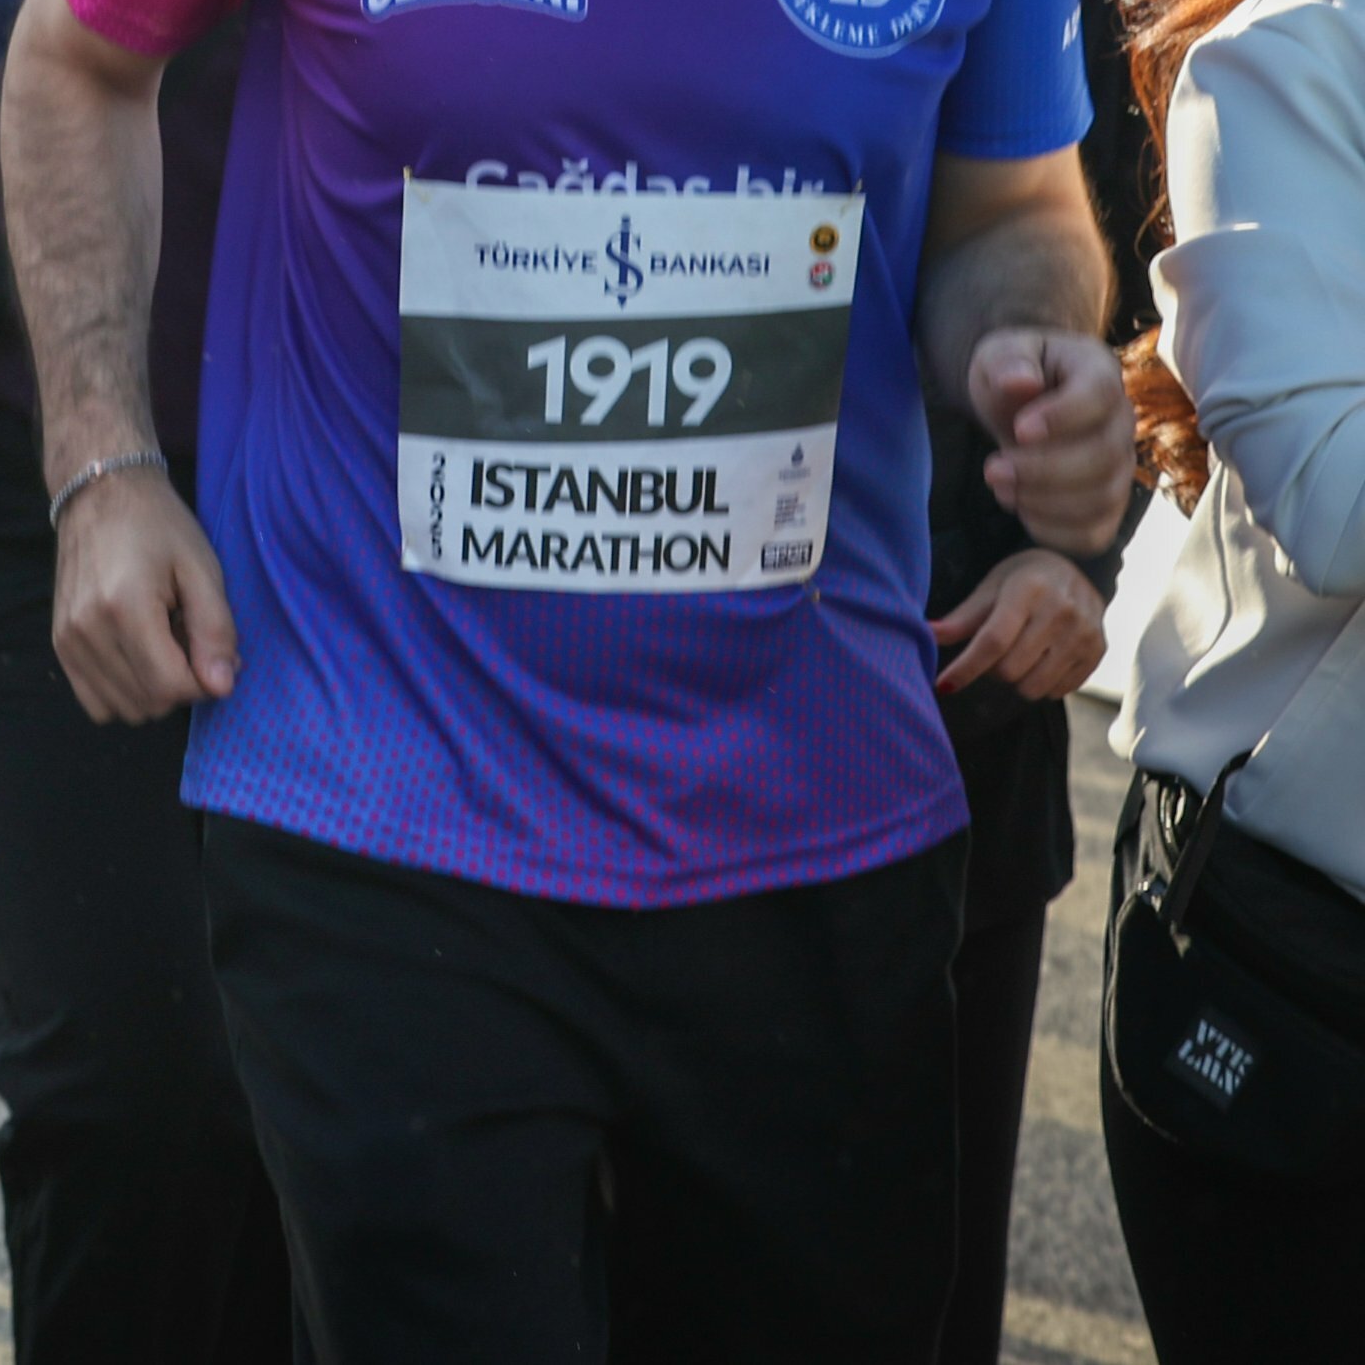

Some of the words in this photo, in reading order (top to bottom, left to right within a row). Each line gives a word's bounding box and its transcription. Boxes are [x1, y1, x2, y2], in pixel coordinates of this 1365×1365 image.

[474, 240, 597, 275] TÜRKİYE
[649, 251, 770, 276] BANKASI
[527, 334, 733, 427] 1919
[469, 457, 730, 517] ISTANBUL
[459, 524, 732, 574] MARATHON
